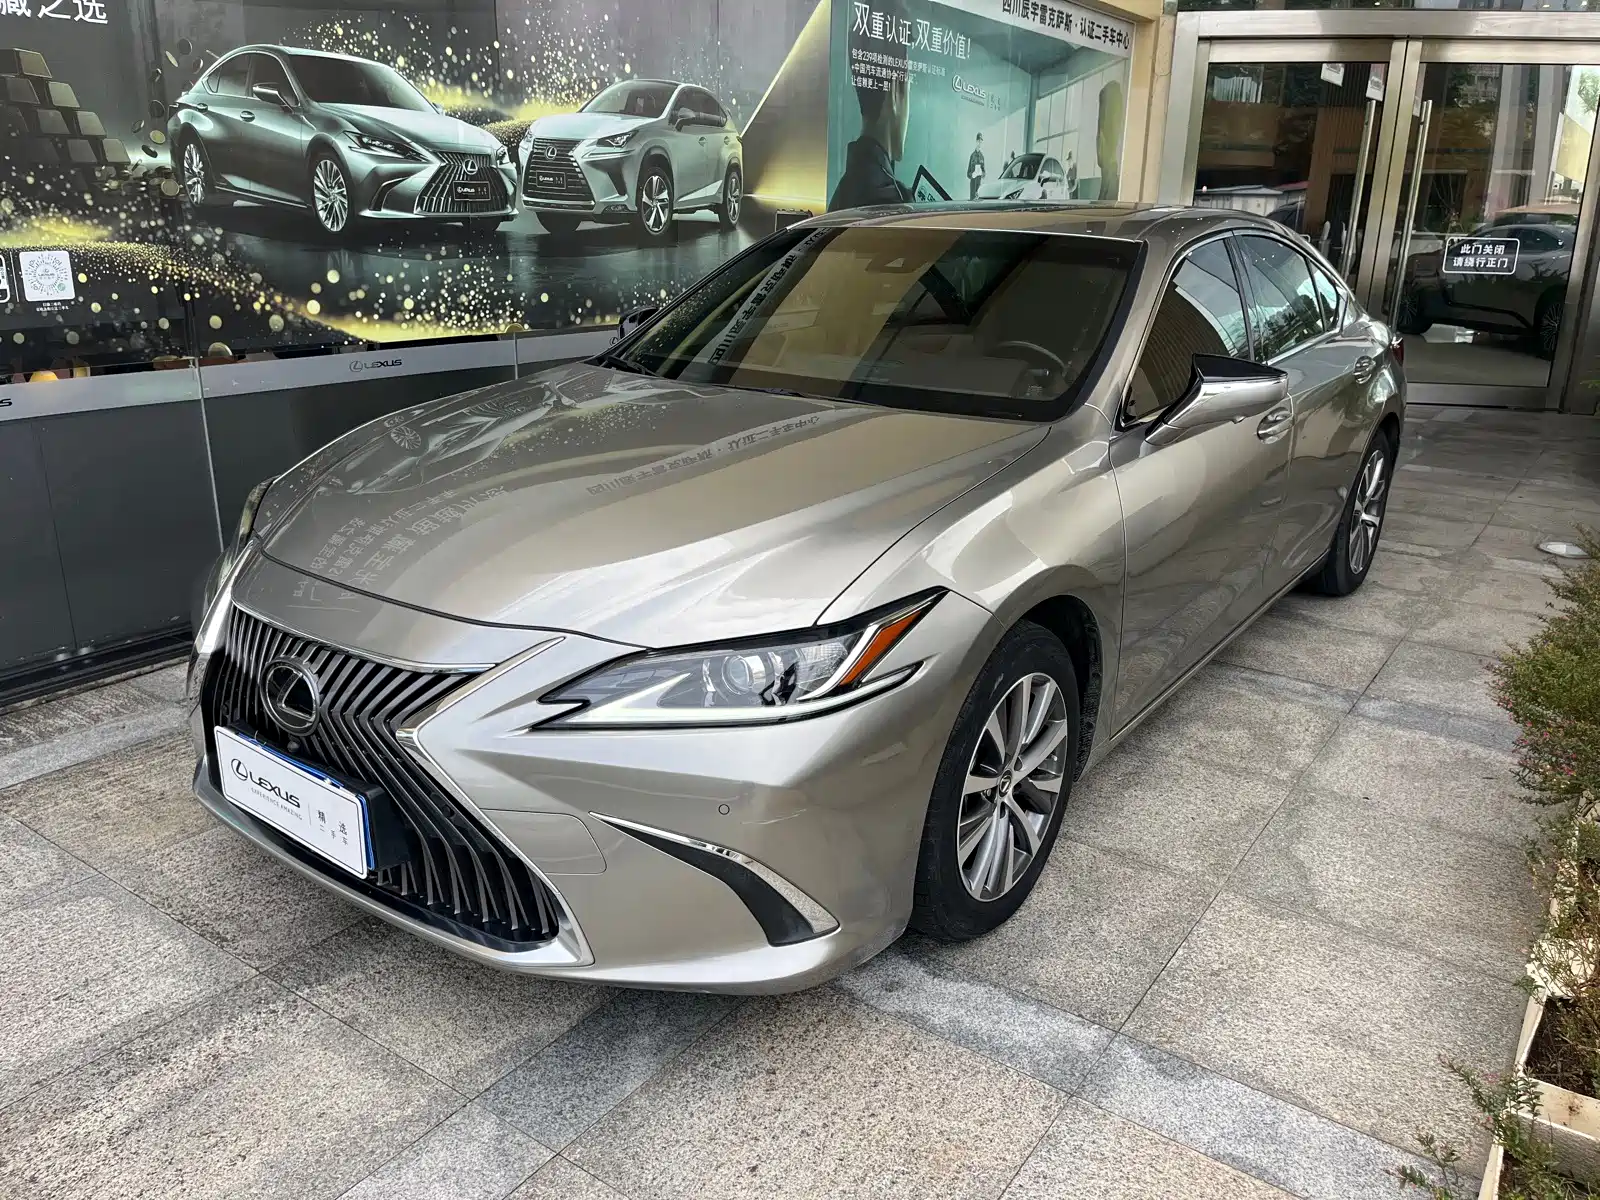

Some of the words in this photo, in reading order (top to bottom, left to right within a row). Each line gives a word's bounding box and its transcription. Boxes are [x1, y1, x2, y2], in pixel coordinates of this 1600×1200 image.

[1460, 244, 1505, 255] 此门关闭
[1453, 256, 1508, 268] 请绕行正门
[364, 359, 402, 369] LEXUS
[249, 769, 301, 808] LEXUS
